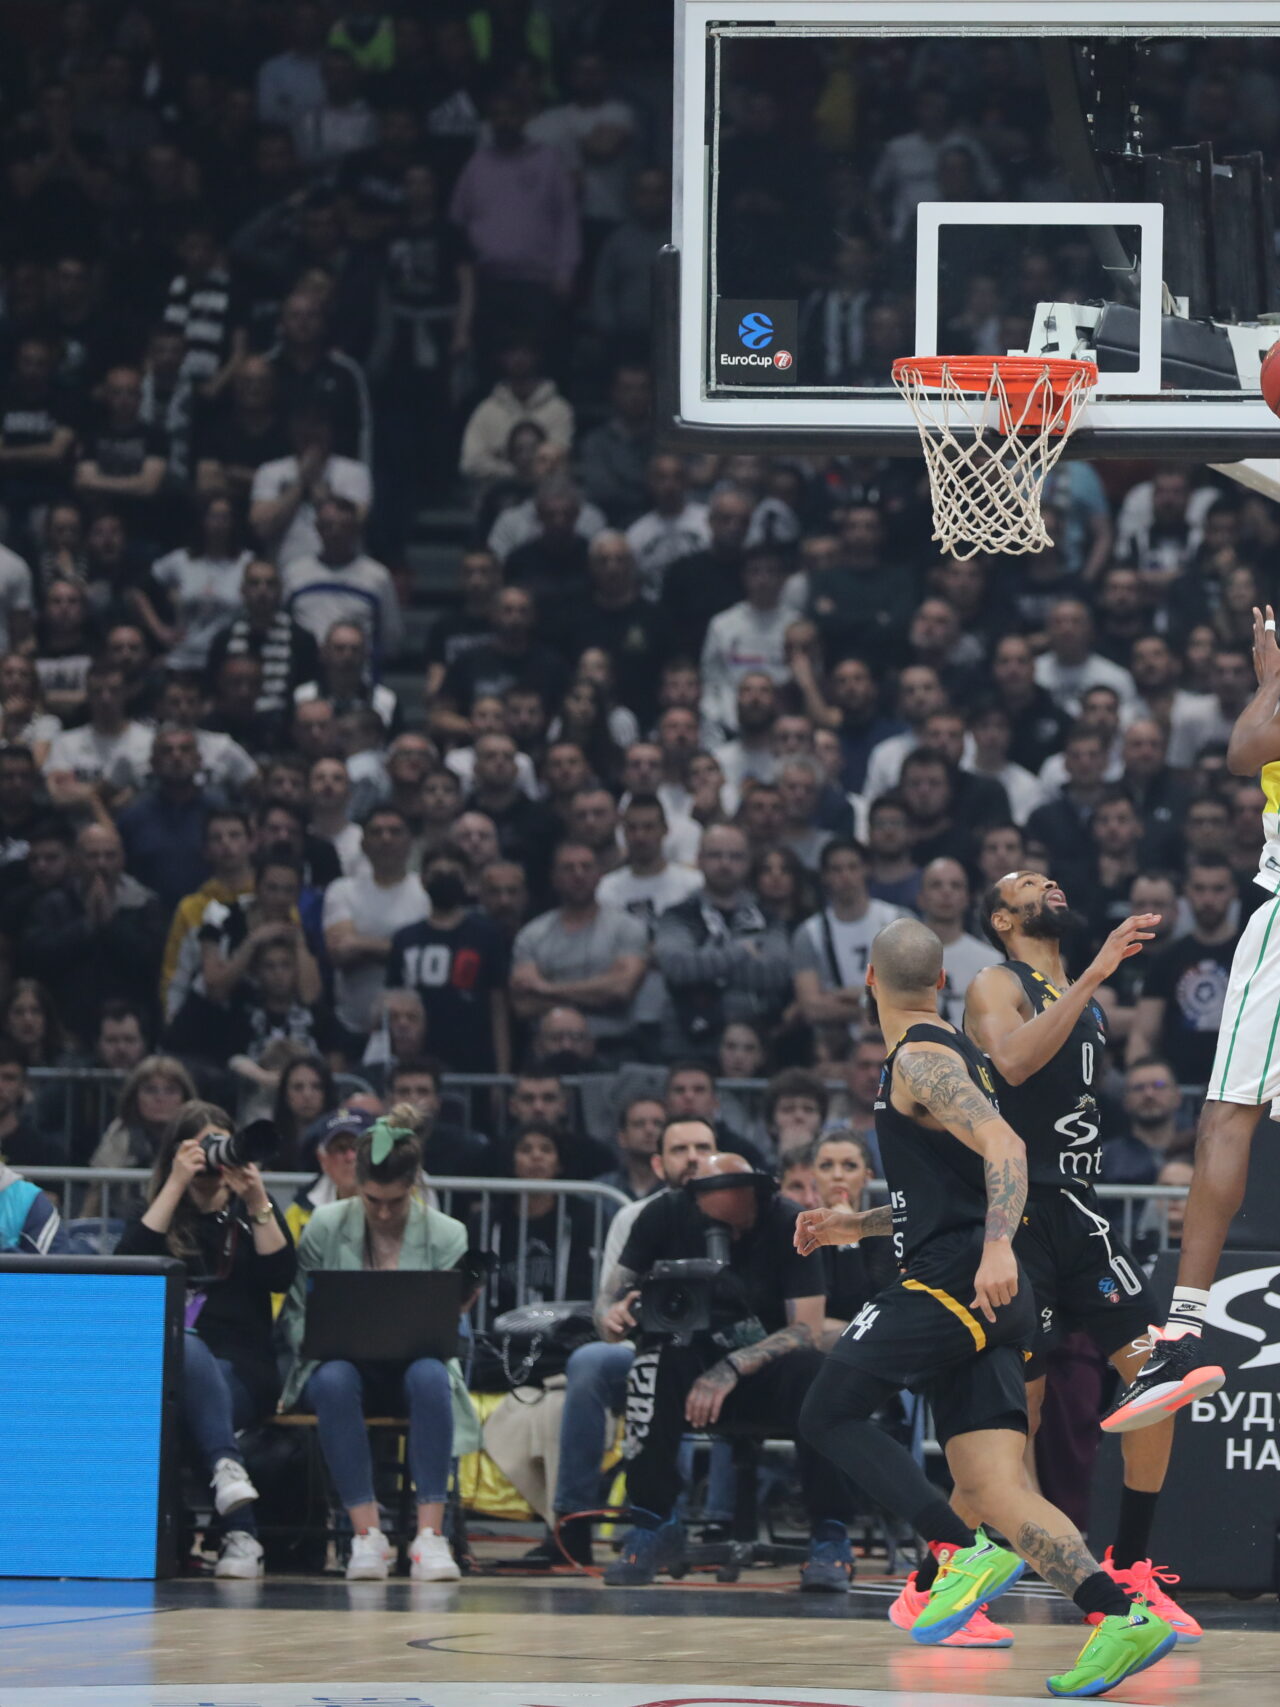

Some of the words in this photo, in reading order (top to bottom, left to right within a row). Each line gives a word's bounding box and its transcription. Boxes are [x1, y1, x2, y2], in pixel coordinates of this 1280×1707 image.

[720, 353, 772, 368] EuroCup
[1082, 1042, 1093, 1085] 0
[891, 1191, 906, 1209] IS
